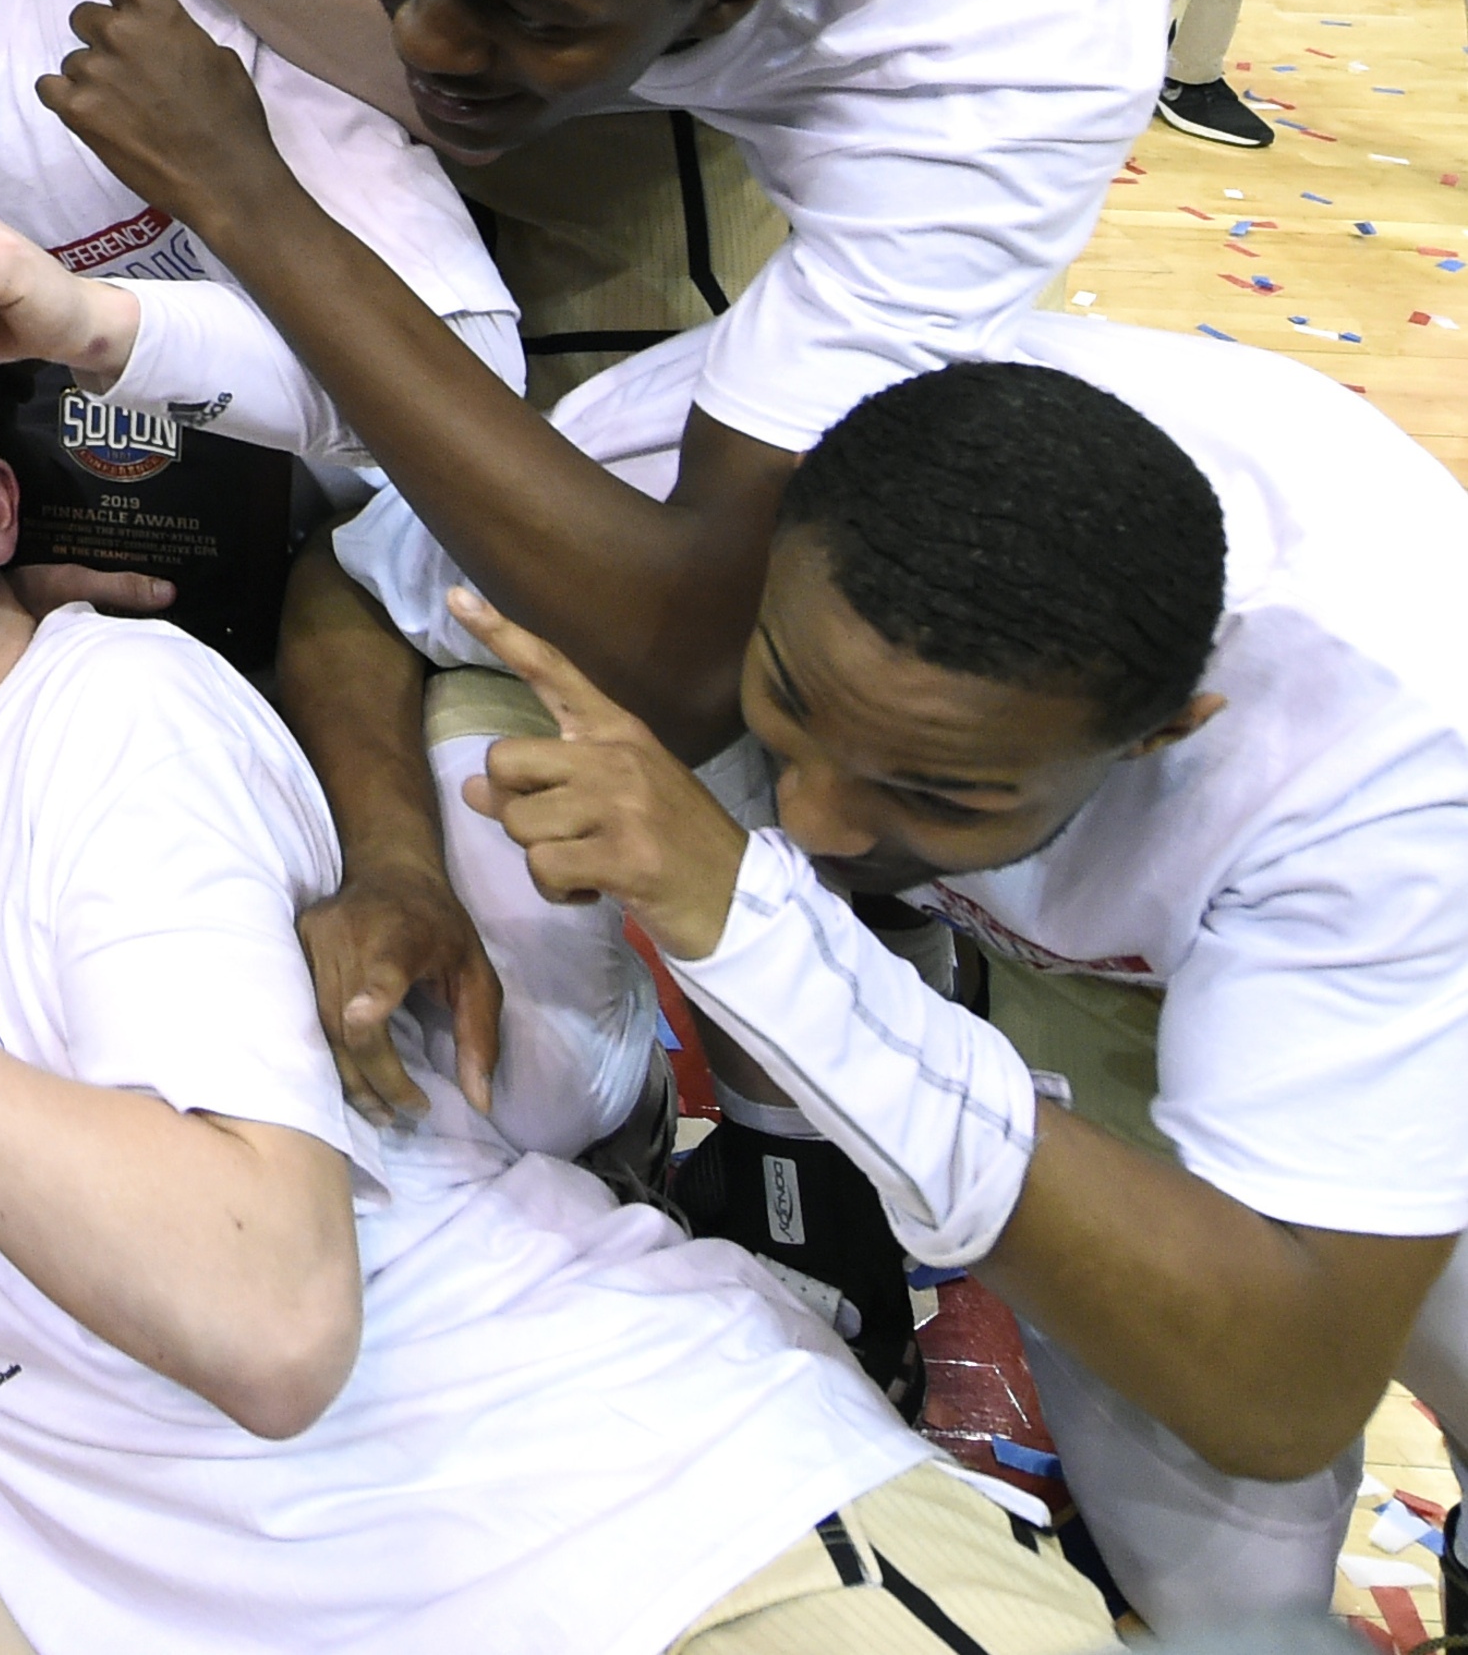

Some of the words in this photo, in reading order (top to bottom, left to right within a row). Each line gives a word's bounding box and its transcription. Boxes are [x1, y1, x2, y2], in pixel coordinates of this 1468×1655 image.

[100, 493, 141, 509] 2019
[42, 505, 128, 525] PINNACLE
[133, 512, 200, 531] AWARD
